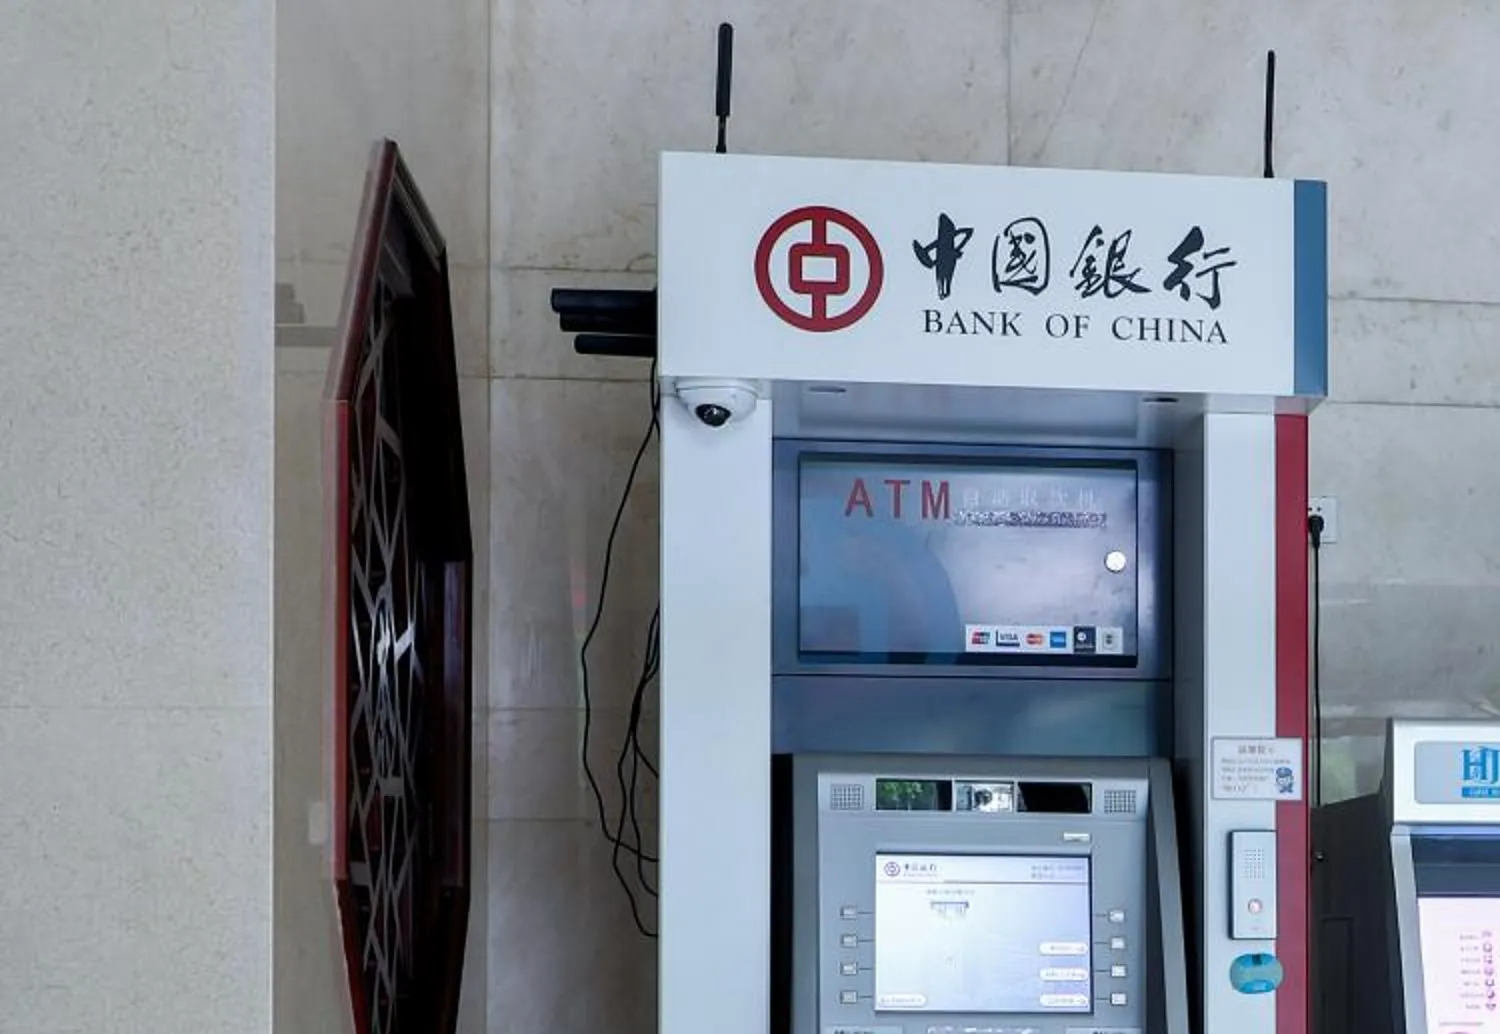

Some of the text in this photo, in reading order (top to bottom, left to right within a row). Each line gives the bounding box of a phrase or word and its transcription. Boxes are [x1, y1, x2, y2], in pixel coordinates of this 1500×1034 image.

[923, 309, 1228, 344] BANK OF CHINA
[844, 477, 950, 520] ATM
[999, 632, 1019, 641] VISA
